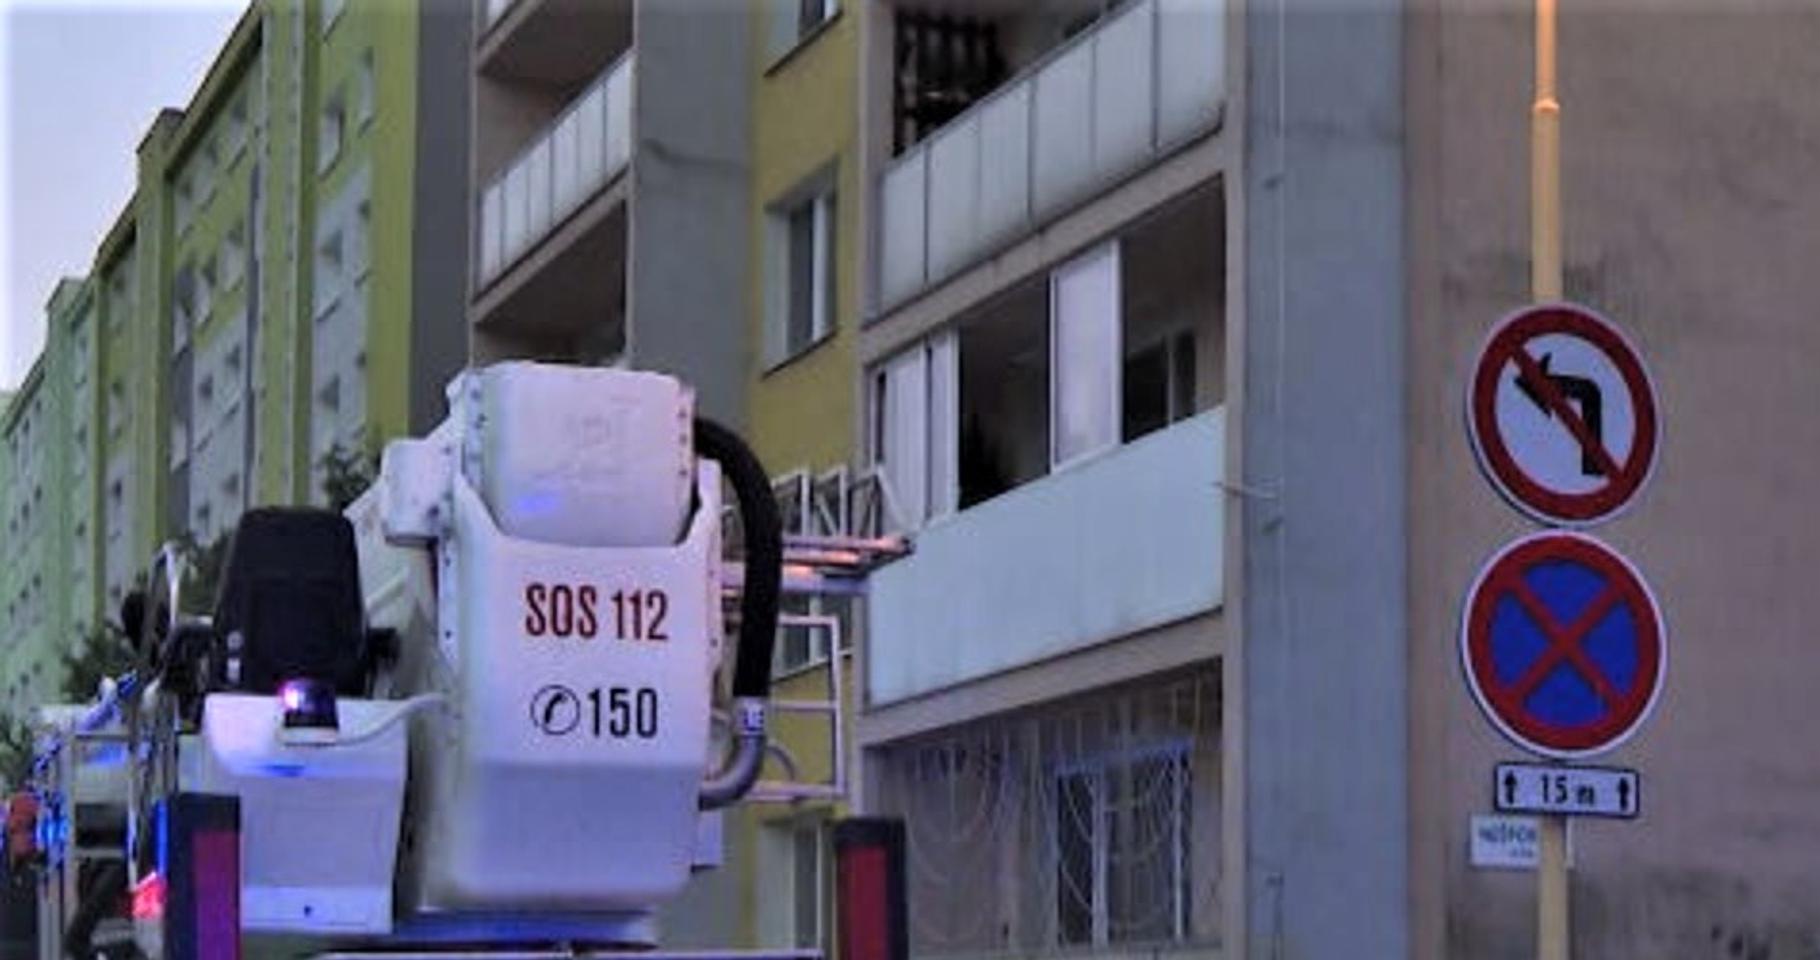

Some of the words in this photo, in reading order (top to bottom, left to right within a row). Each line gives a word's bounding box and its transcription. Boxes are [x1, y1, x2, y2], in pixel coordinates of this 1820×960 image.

[525, 583, 597, 639] SOS
[610, 589, 668, 640] 112
[588, 687, 658, 738] 150
[1541, 774, 1568, 803] 15
[1577, 785, 1595, 804] m
